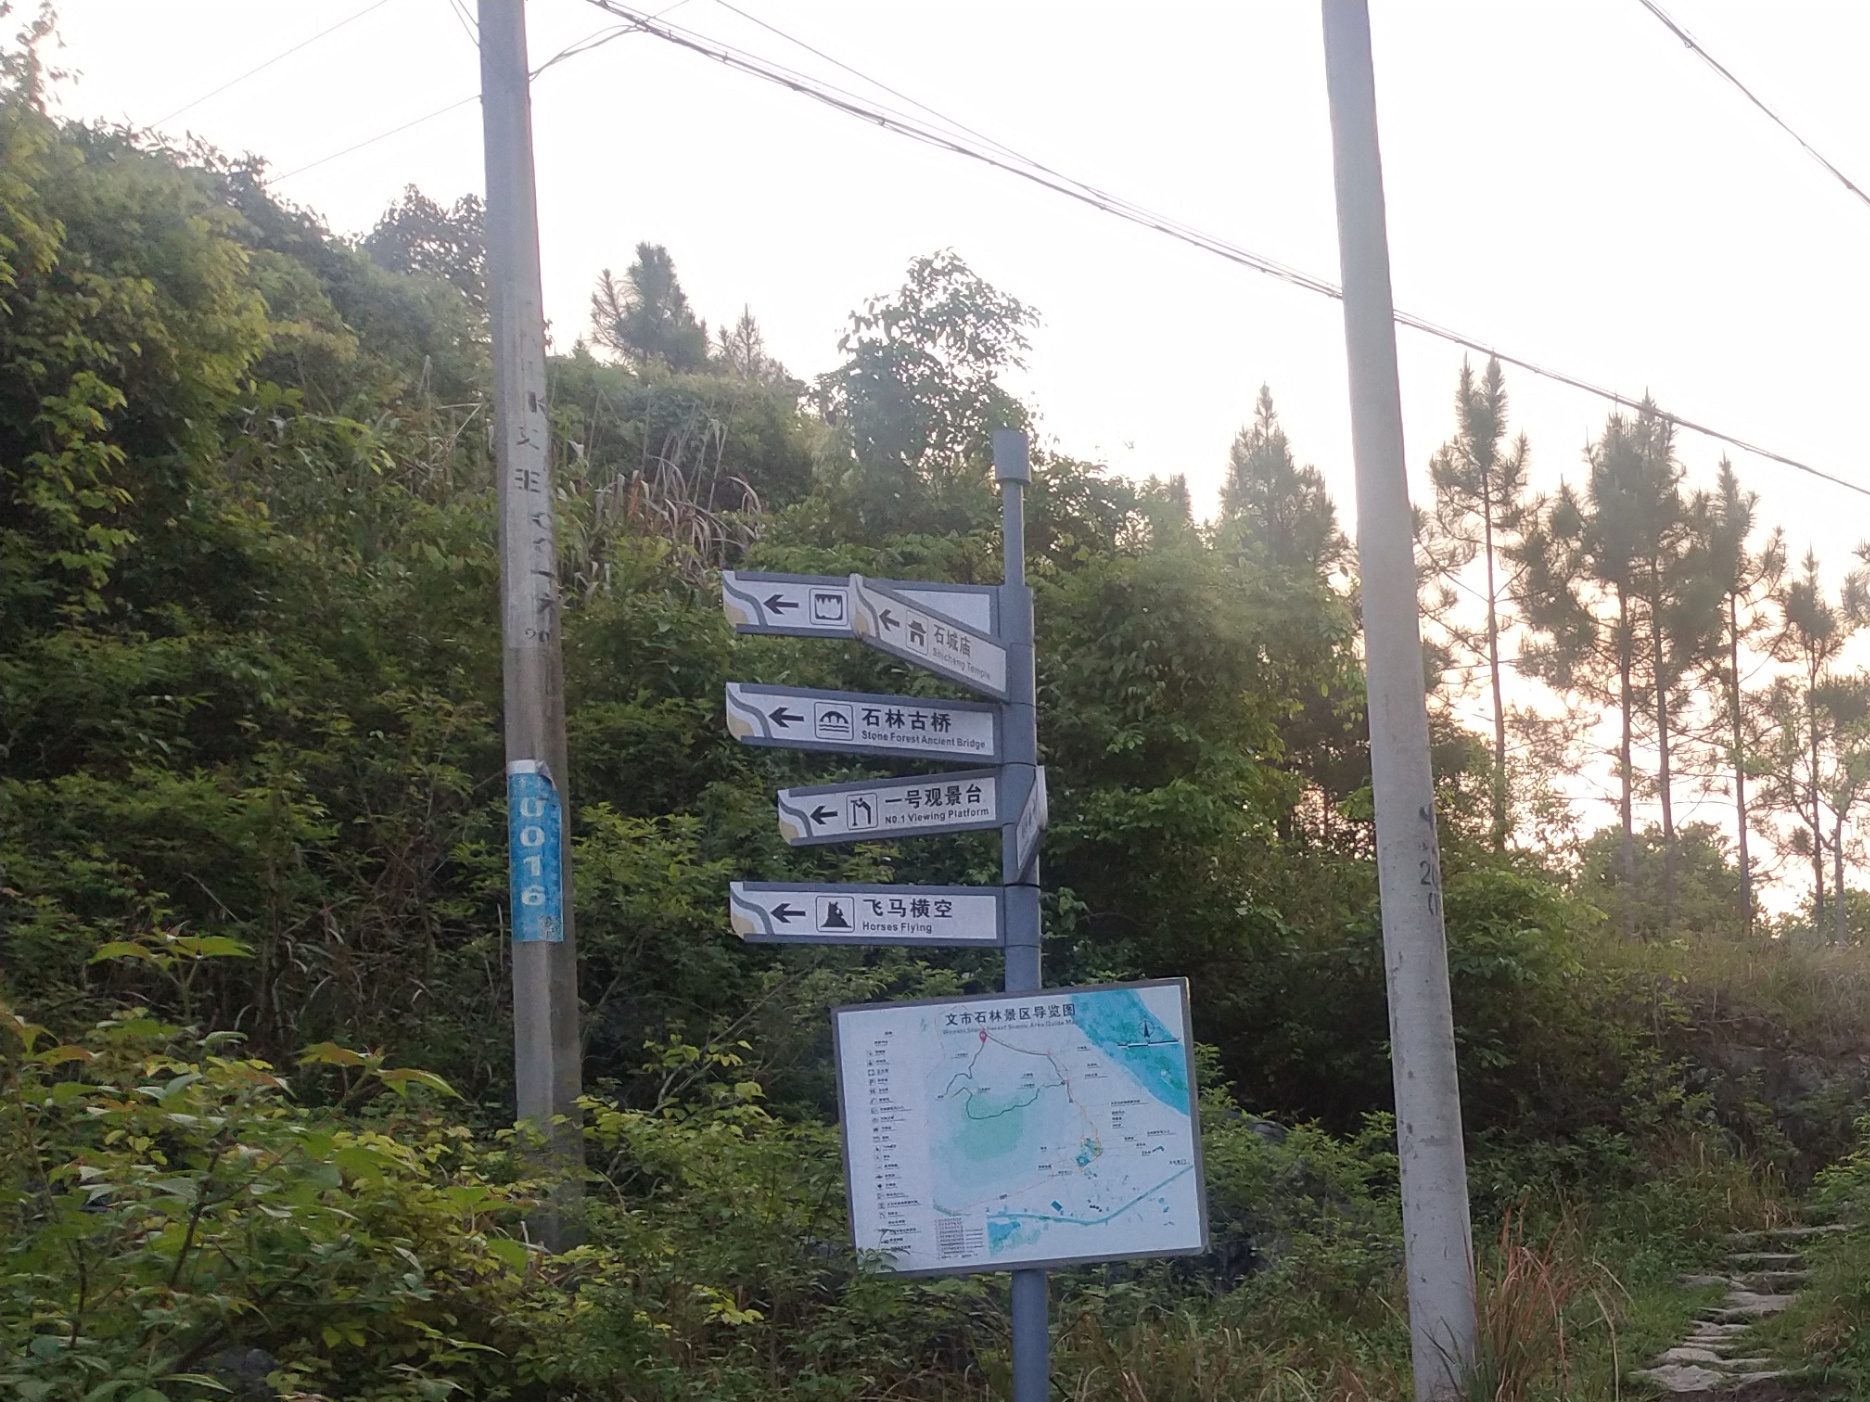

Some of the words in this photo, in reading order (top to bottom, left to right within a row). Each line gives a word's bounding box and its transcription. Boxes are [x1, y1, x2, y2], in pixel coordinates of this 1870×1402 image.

[933, 624, 971, 657] 石城庙
[967, 662, 991, 680] Temple
[861, 707, 952, 733] 石林古桥
[861, 730, 888, 741] Stone
[890, 732, 919, 744] Forest
[921, 735, 955, 746] Ancient
[957, 738, 986, 750] Bridge
[885, 783, 982, 809] 一号观景台
[908, 811, 946, 821] Viewing
[948, 807, 989, 819] Platform
[519, 796, 547, 907] 0016
[862, 898, 953, 919] 飞马横空
[862, 921, 899, 932] Horses
[901, 922, 932, 935] Flying
[944, 1003, 1076, 1027] 文市石林景区导览图
